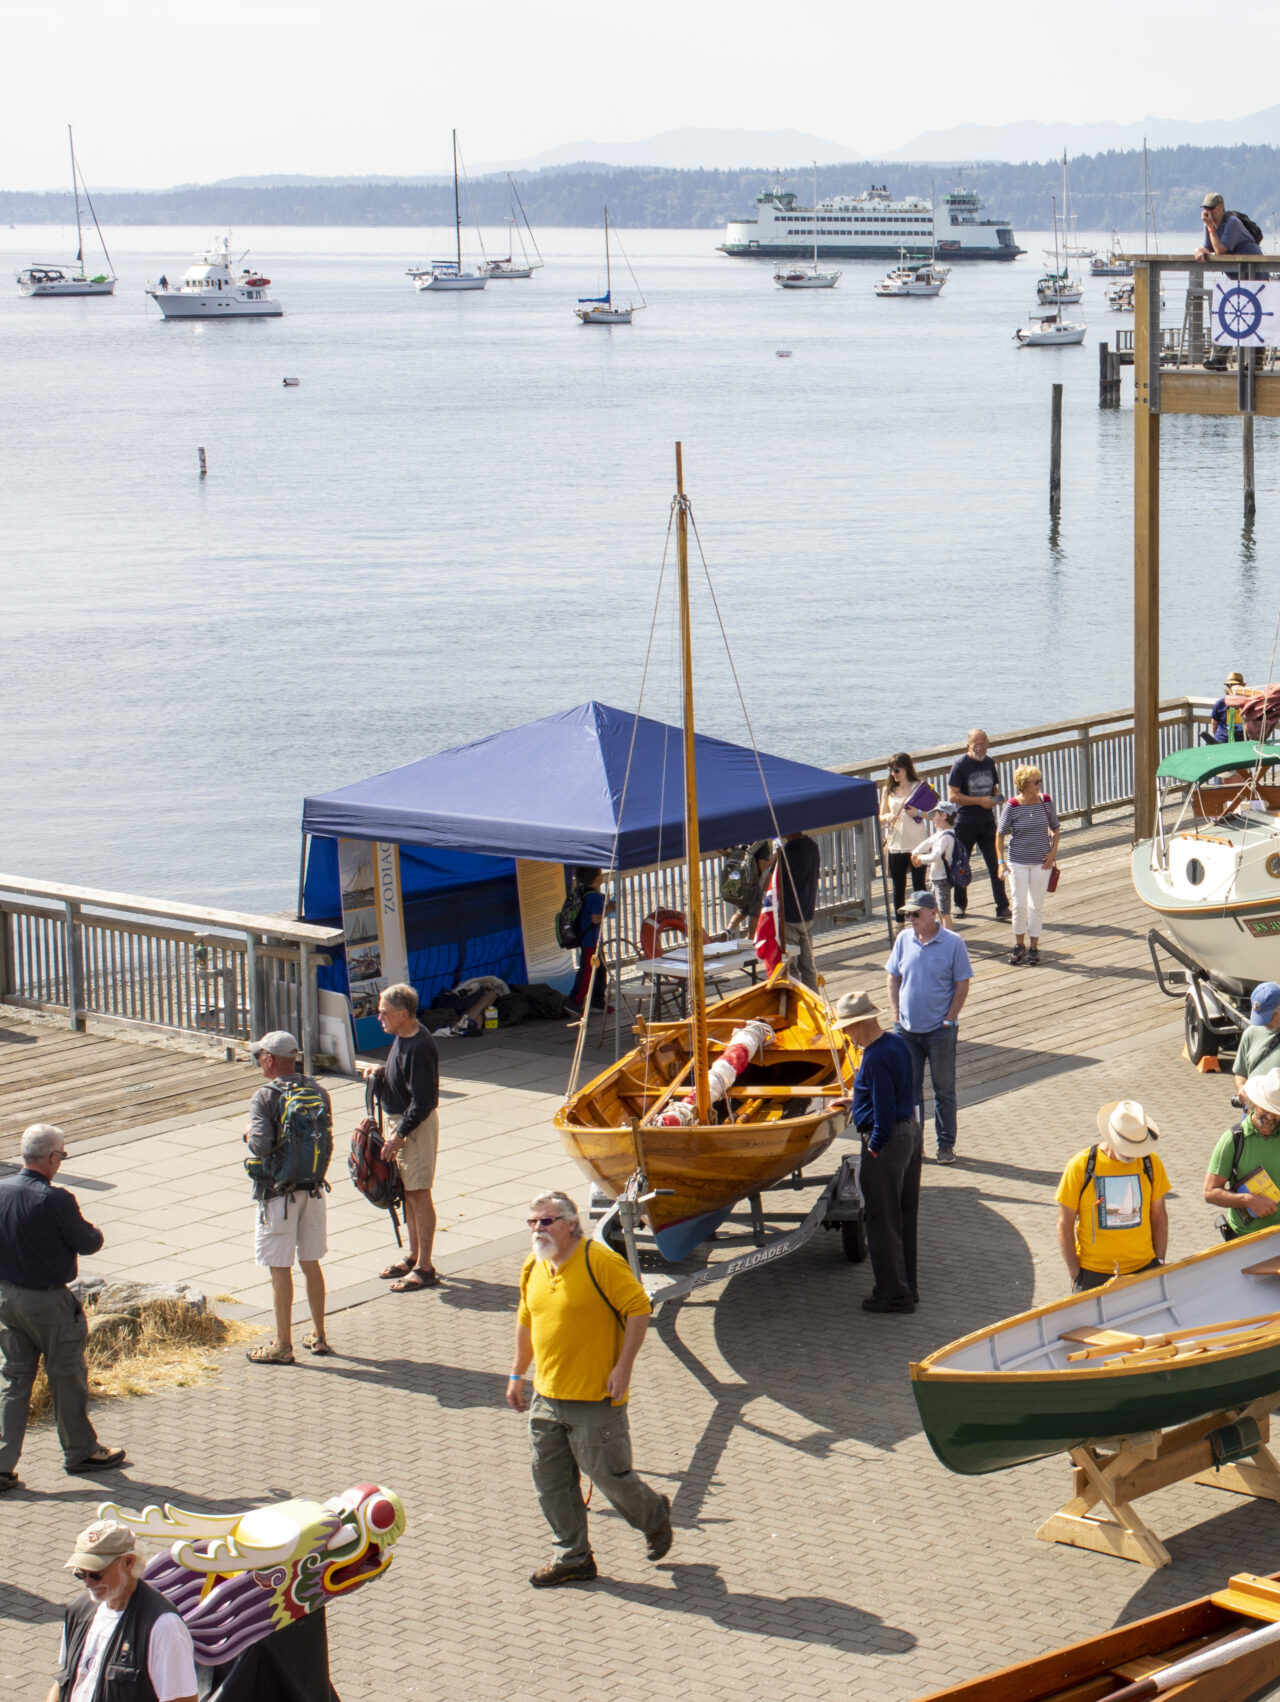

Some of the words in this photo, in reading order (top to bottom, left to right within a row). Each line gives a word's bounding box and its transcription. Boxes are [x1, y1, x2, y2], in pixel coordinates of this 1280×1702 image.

[380, 841, 396, 914] ZODIAC
[727, 1258, 745, 1275] EZ
[744, 1241, 790, 1268] LOADER
